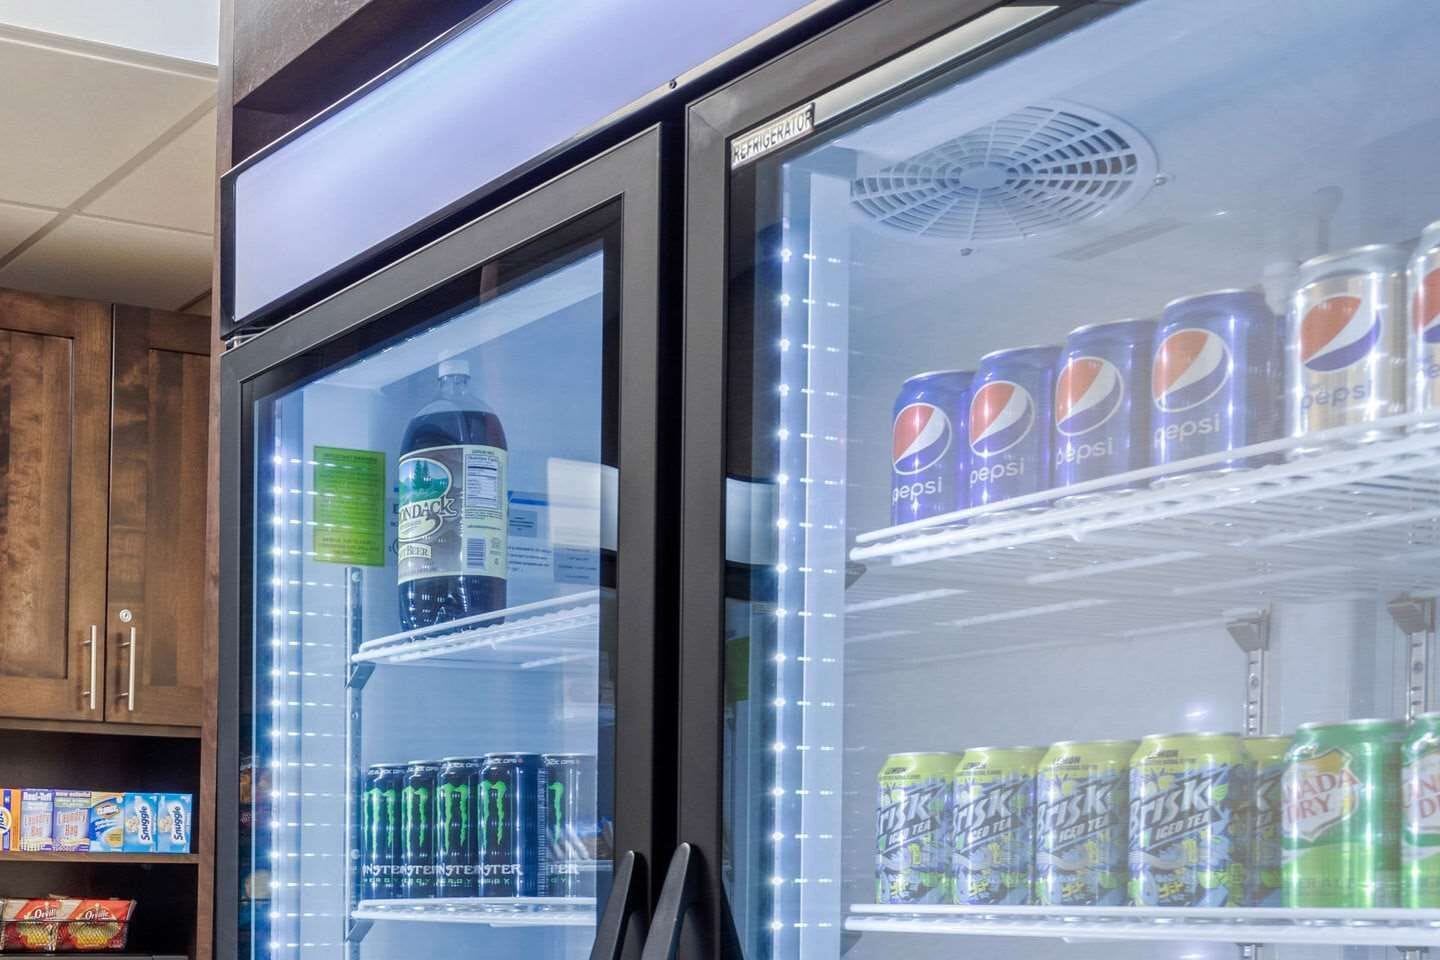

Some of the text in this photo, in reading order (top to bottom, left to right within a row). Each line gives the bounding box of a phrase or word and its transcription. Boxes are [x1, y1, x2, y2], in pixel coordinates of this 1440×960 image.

[733, 110, 814, 160] REFRIGERATOR
[1153, 413, 1220, 449] pepsi
[1056, 437, 1113, 469] pepsi
[969, 457, 1024, 485] pepsi
[892, 477, 942, 504] pepsi
[401, 497, 457, 519] NDACK
[1285, 768, 1360, 802] NADA
[141, 805, 150, 841] Snuggle
[173, 805, 184, 841] Snuggle
[877, 791, 934, 835] risk
[913, 820, 932, 833] TEA
[954, 787, 1014, 837] risk
[1156, 812, 1210, 841] ICED TEA
[1060, 824, 1084, 842] ICED
[478, 865, 522, 876] NSTER
[34, 907, 56, 919] Orvill
